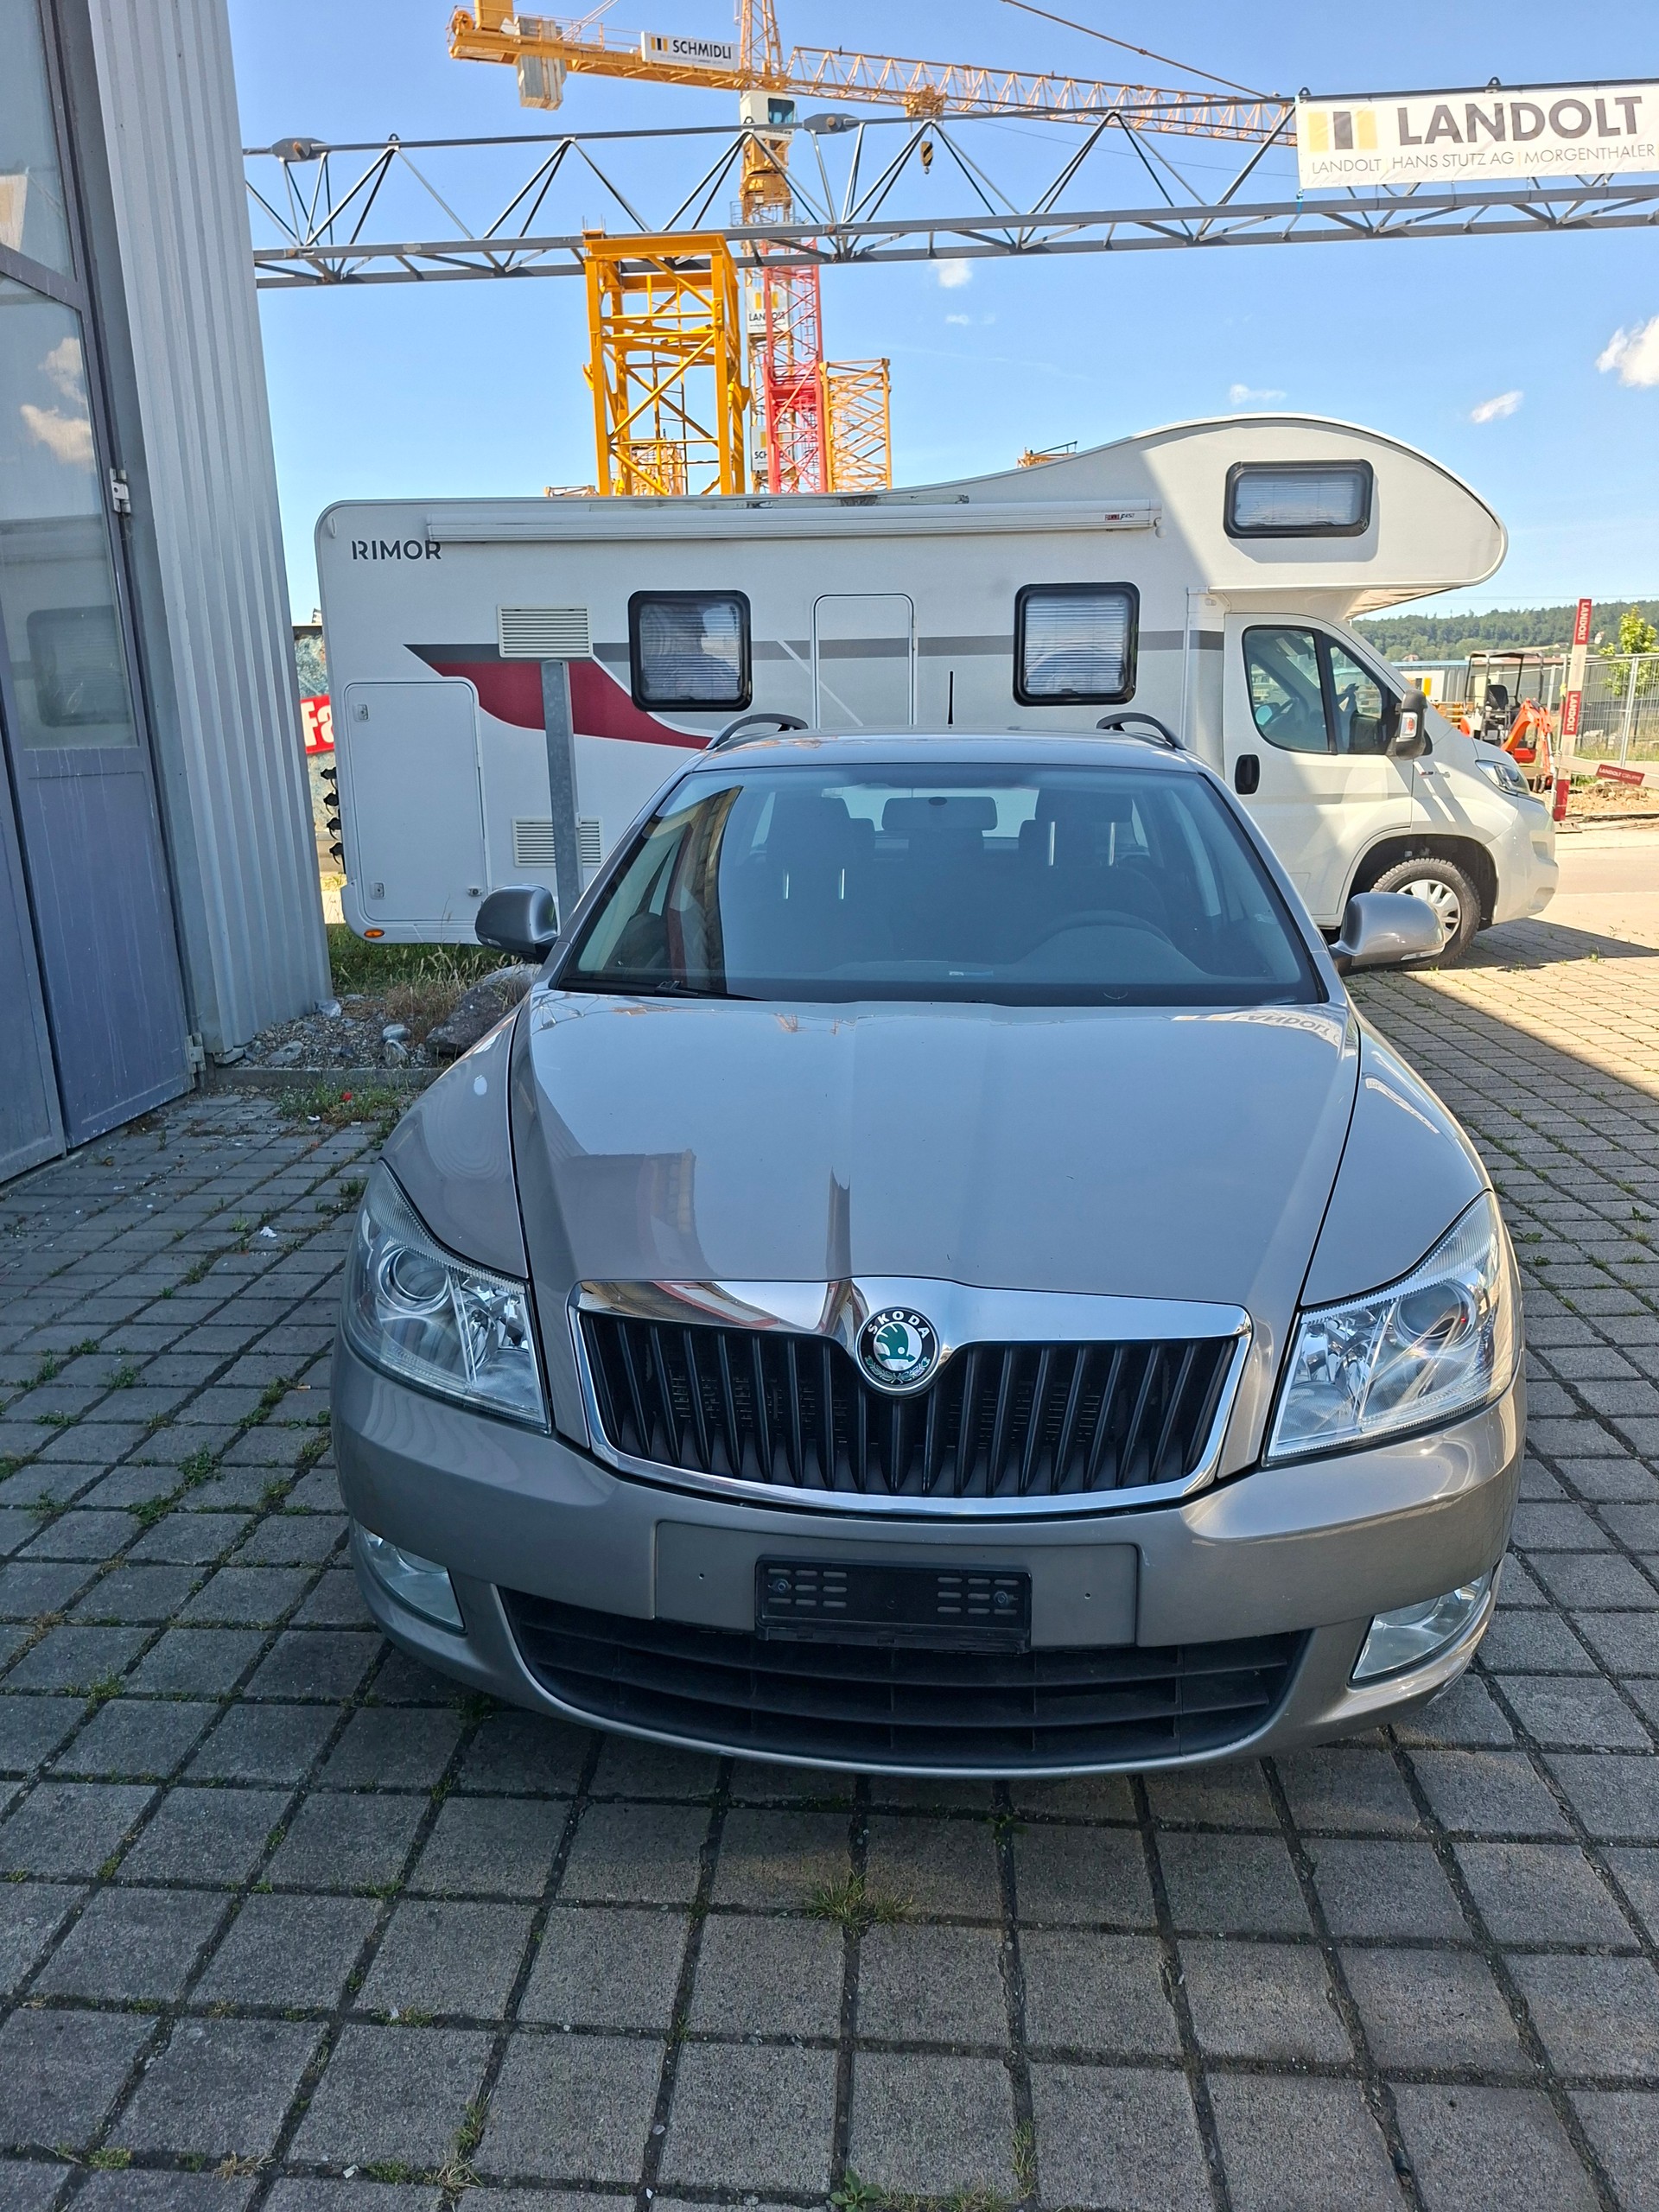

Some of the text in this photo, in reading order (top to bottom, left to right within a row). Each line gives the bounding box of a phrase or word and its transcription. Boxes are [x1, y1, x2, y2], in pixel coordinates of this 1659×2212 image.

[672, 39, 732, 60] SCHMIDLI
[1397, 96, 1643, 146] LANDOLT
[1312, 143, 1656, 175] LANDOLT HANS STUTZ AG MORGENTHALER
[352, 539, 442, 560] RIMOR
[1577, 602, 1590, 641] LANDOLT
[1566, 694, 1579, 732] LANDOLT
[868, 1310, 931, 1339] SKODA
